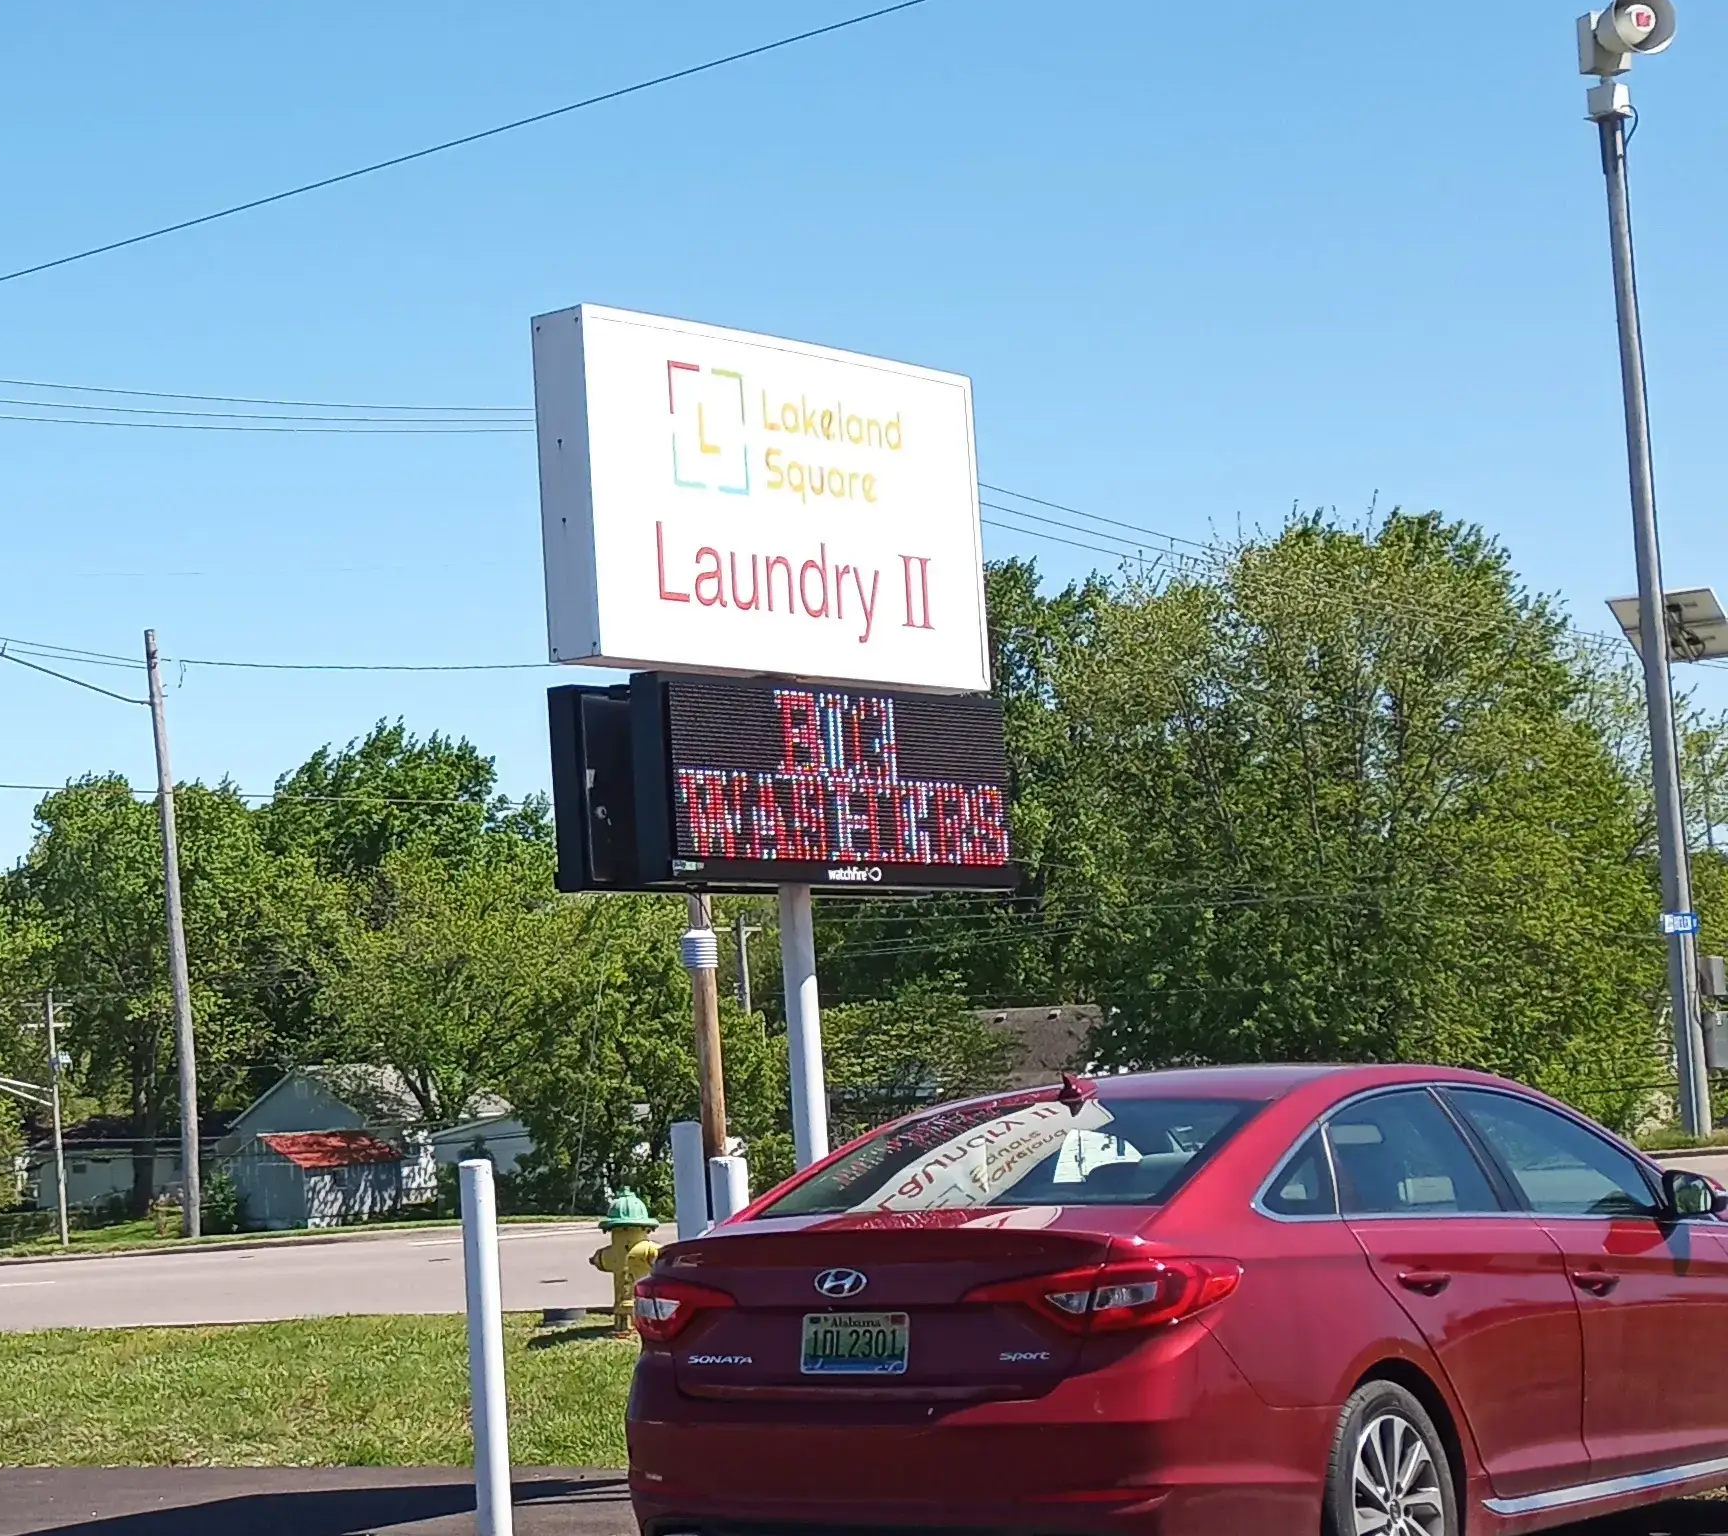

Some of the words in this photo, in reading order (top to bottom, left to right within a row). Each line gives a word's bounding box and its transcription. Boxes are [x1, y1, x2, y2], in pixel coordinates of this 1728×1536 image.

[762, 388, 903, 451] Lakeland
[764, 447, 878, 505] Square
[656, 520, 880, 644] Laundry
[898, 554, 936, 631] II
[812, 1328, 897, 1358] 1DL2301
[831, 1315, 881, 1327] Alabama
[687, 1355, 753, 1365] SONATA
